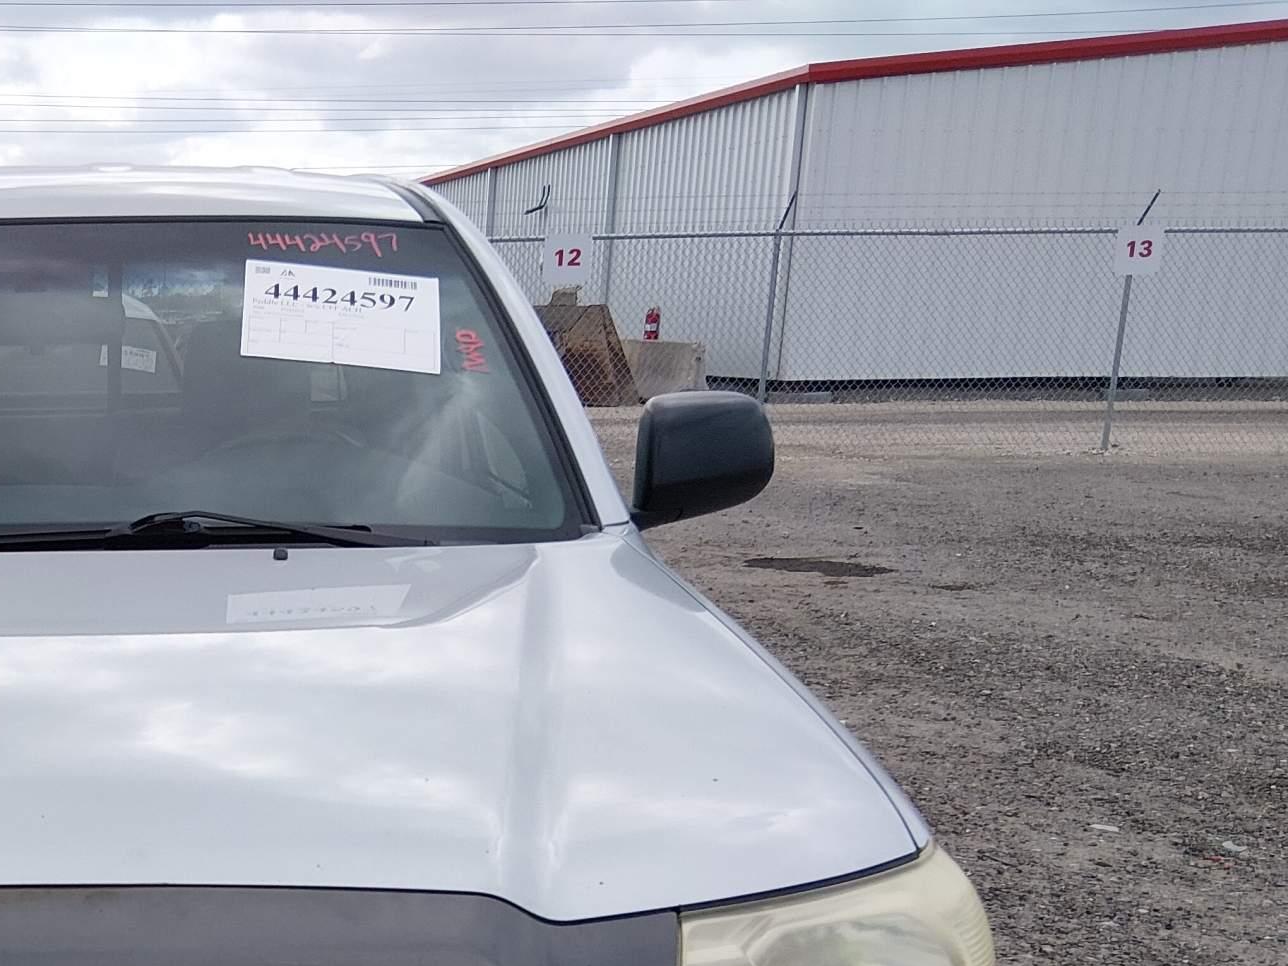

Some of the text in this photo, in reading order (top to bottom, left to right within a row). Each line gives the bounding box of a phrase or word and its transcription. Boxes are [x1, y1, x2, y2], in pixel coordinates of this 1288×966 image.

[248, 232, 398, 257] 44424597
[1127, 240, 1153, 258] 13
[554, 248, 582, 267] 12
[264, 283, 415, 312] 44424597
